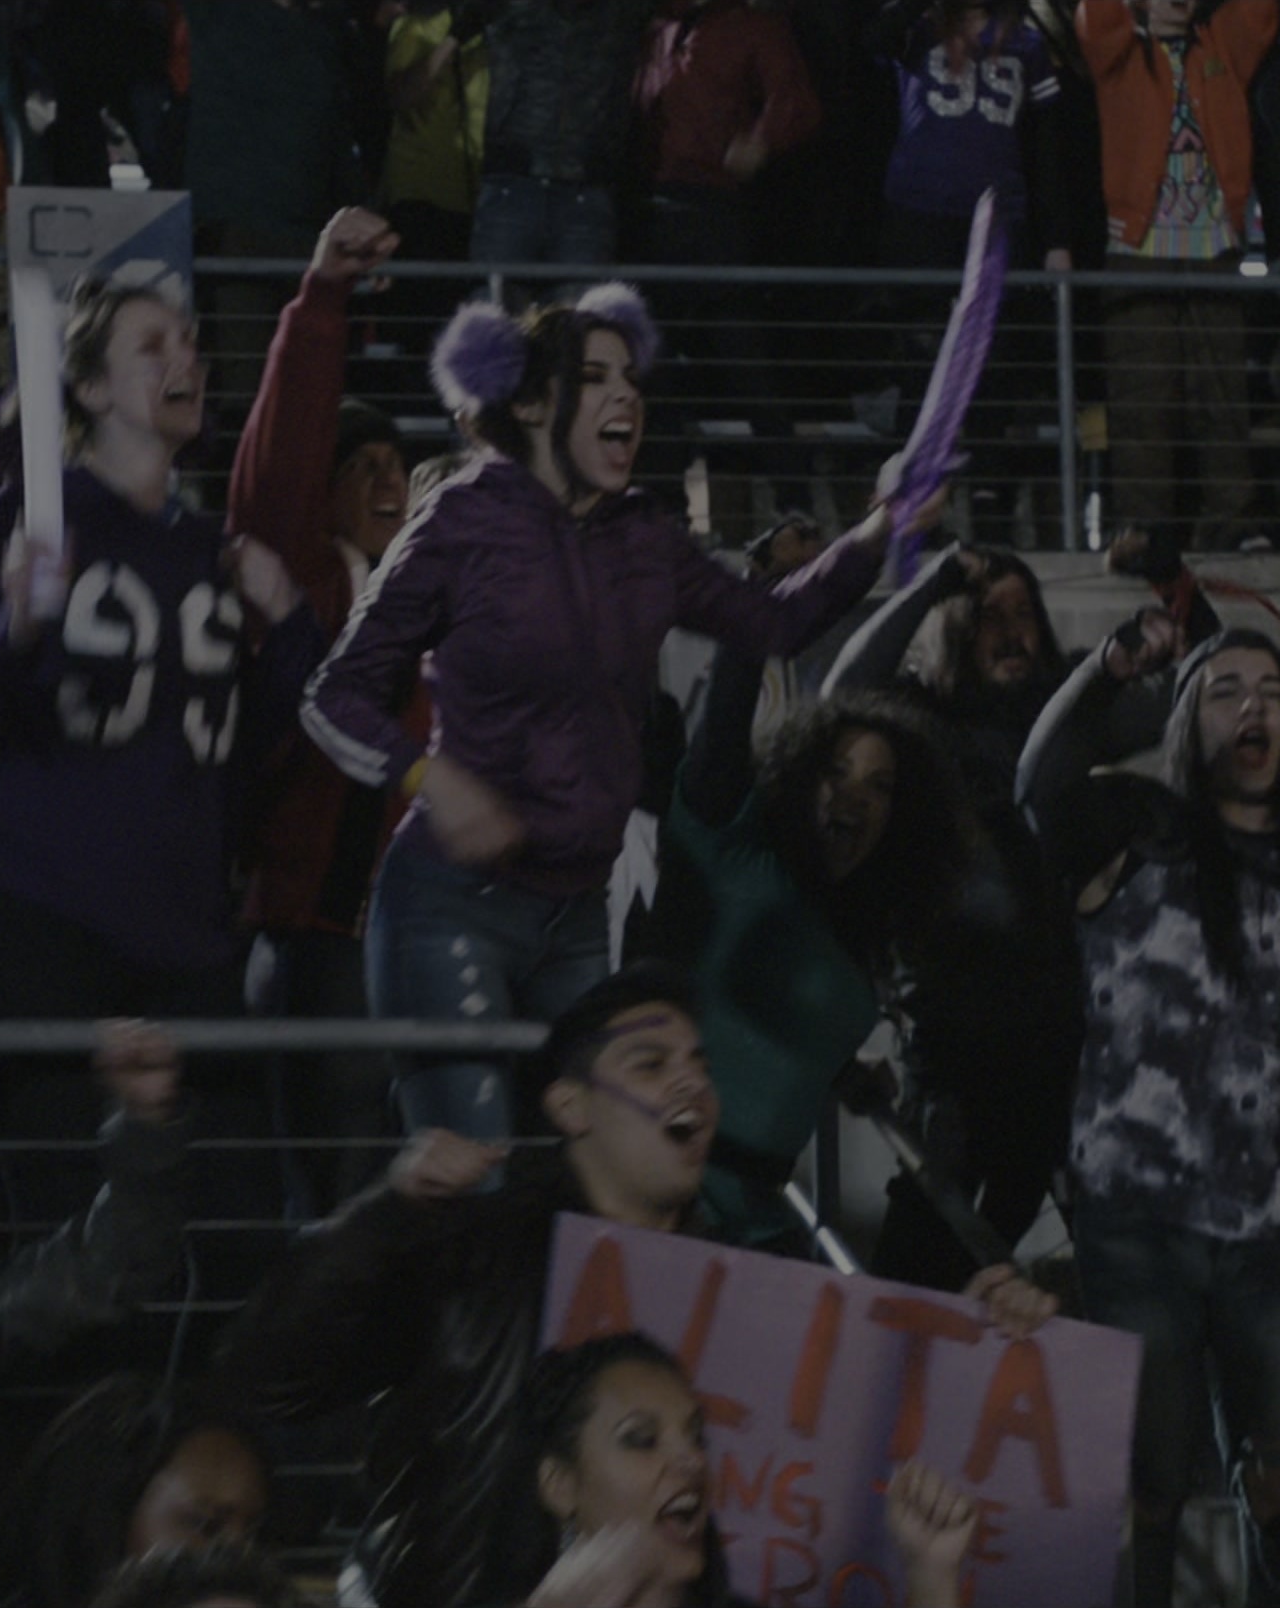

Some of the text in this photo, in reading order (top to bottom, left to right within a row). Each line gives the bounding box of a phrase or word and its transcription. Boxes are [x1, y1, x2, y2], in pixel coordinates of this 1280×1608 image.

[926, 43, 1024, 128] 99
[57, 559, 244, 766] 99
[558, 1236, 1070, 1508] ALITA
